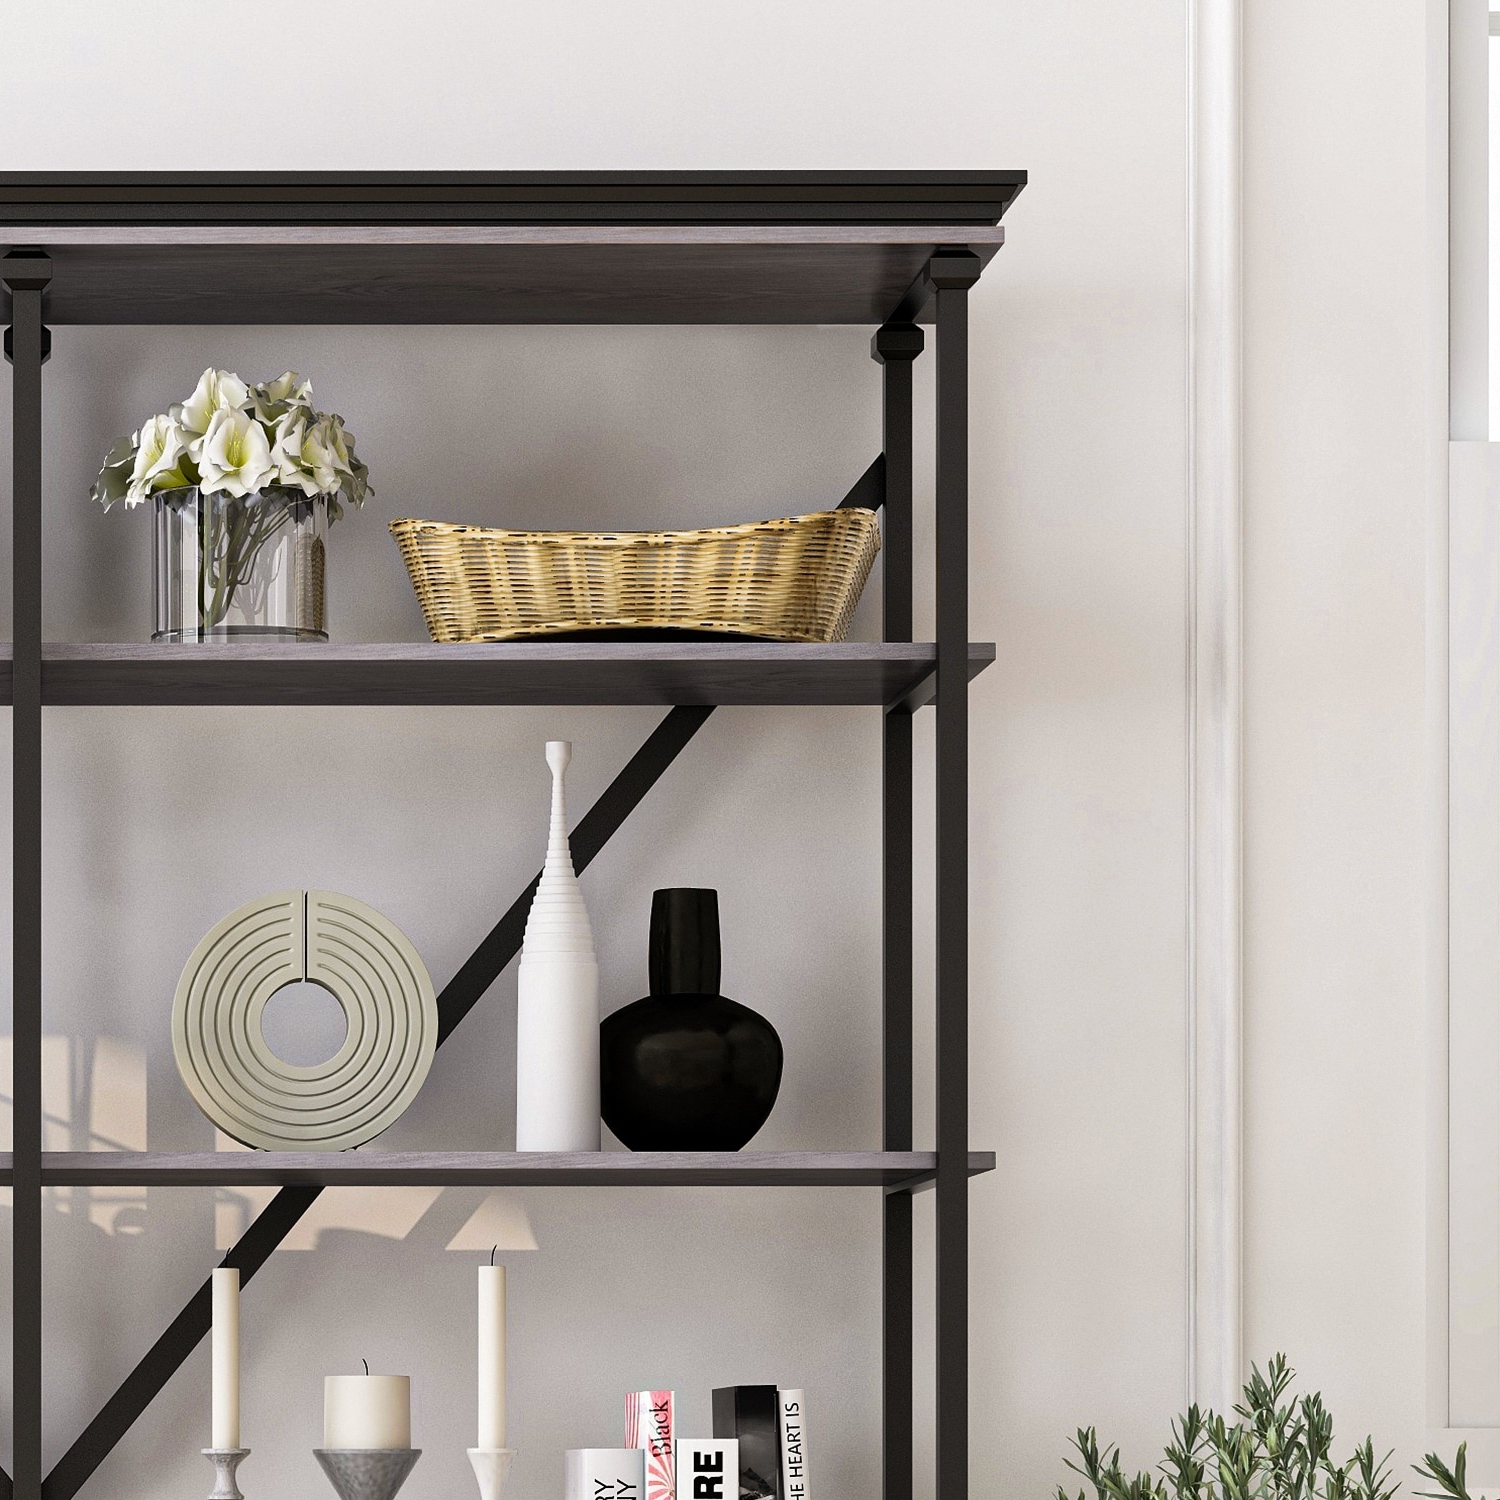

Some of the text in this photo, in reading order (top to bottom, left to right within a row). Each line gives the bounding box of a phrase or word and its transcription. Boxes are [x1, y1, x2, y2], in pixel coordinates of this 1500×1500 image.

[649, 1400, 672, 1458] Black
[785, 1402, 799, 1417] IS
[786, 1423, 803, 1478] HEART
